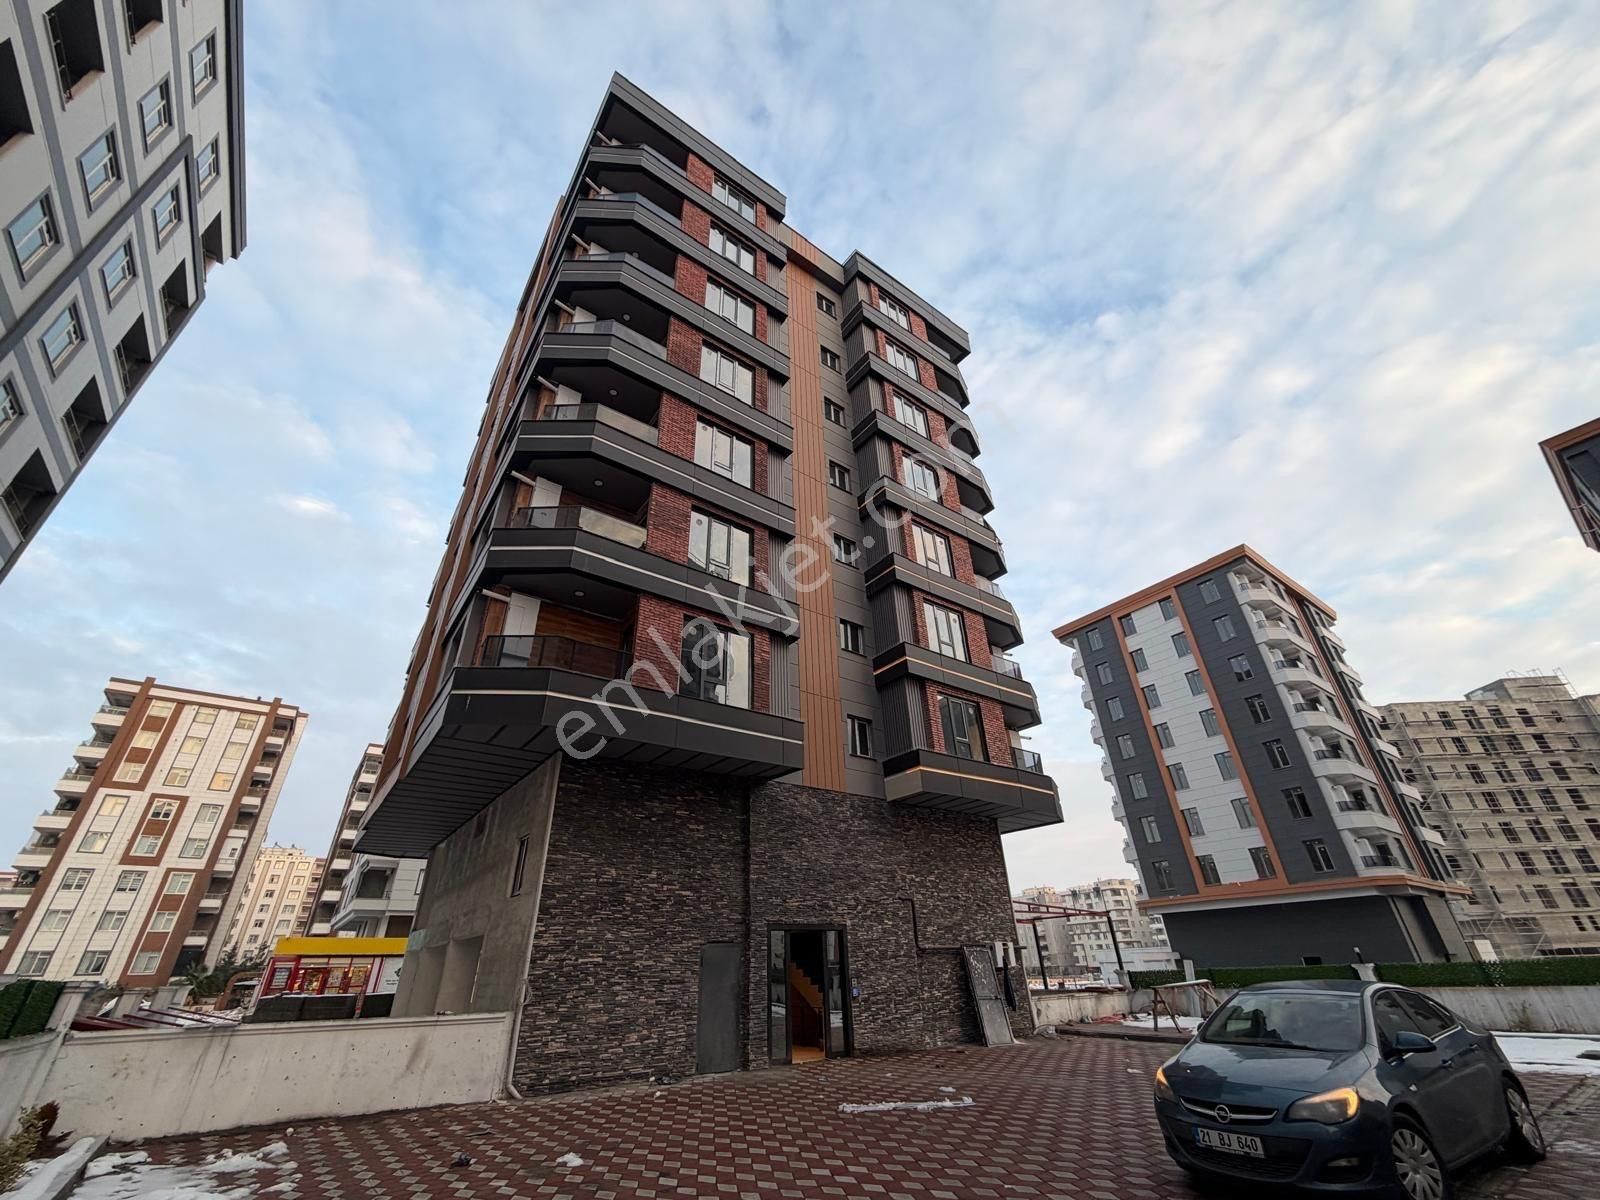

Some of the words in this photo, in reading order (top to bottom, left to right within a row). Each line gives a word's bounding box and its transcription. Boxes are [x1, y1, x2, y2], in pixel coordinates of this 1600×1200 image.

[1200, 1130, 1211, 1144] 21
[1218, 1132, 1232, 1147] BJ
[1236, 1135, 1258, 1152] 640
